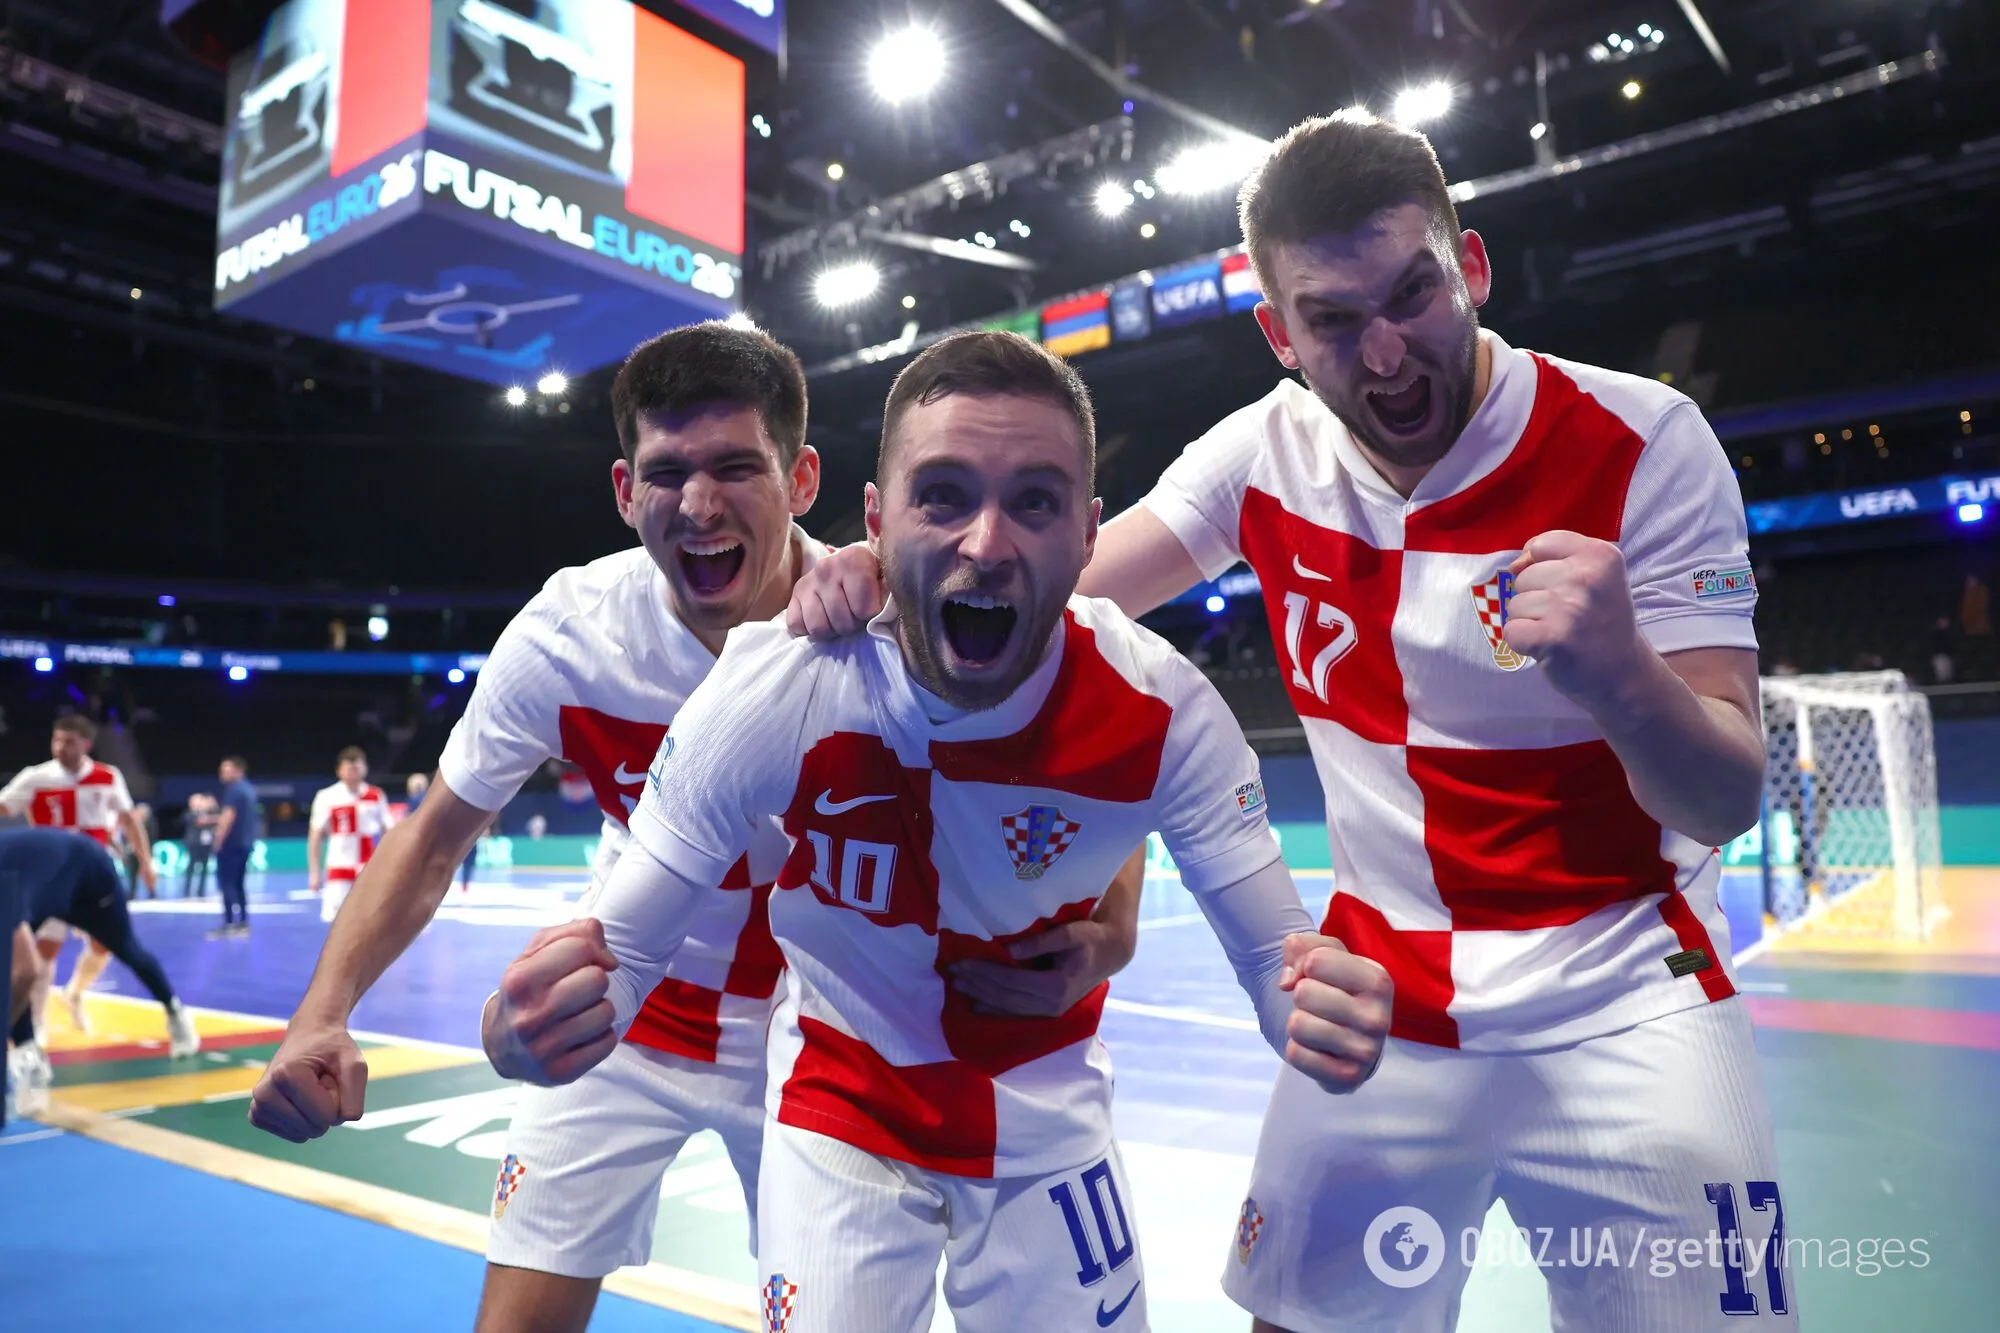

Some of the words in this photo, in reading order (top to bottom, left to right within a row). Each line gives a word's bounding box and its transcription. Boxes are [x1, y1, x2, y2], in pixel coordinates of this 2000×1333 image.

[1152, 278, 1219, 314] UEFA
[1840, 488, 1918, 518] UEFA
[1693, 570, 1717, 580] UEFA
[1284, 591, 1358, 704] 17
[1235, 783, 1254, 796] UEFA
[806, 829, 899, 914] 10
[1048, 1158, 1134, 1288] 10
[1703, 1181, 1788, 1316] 17
